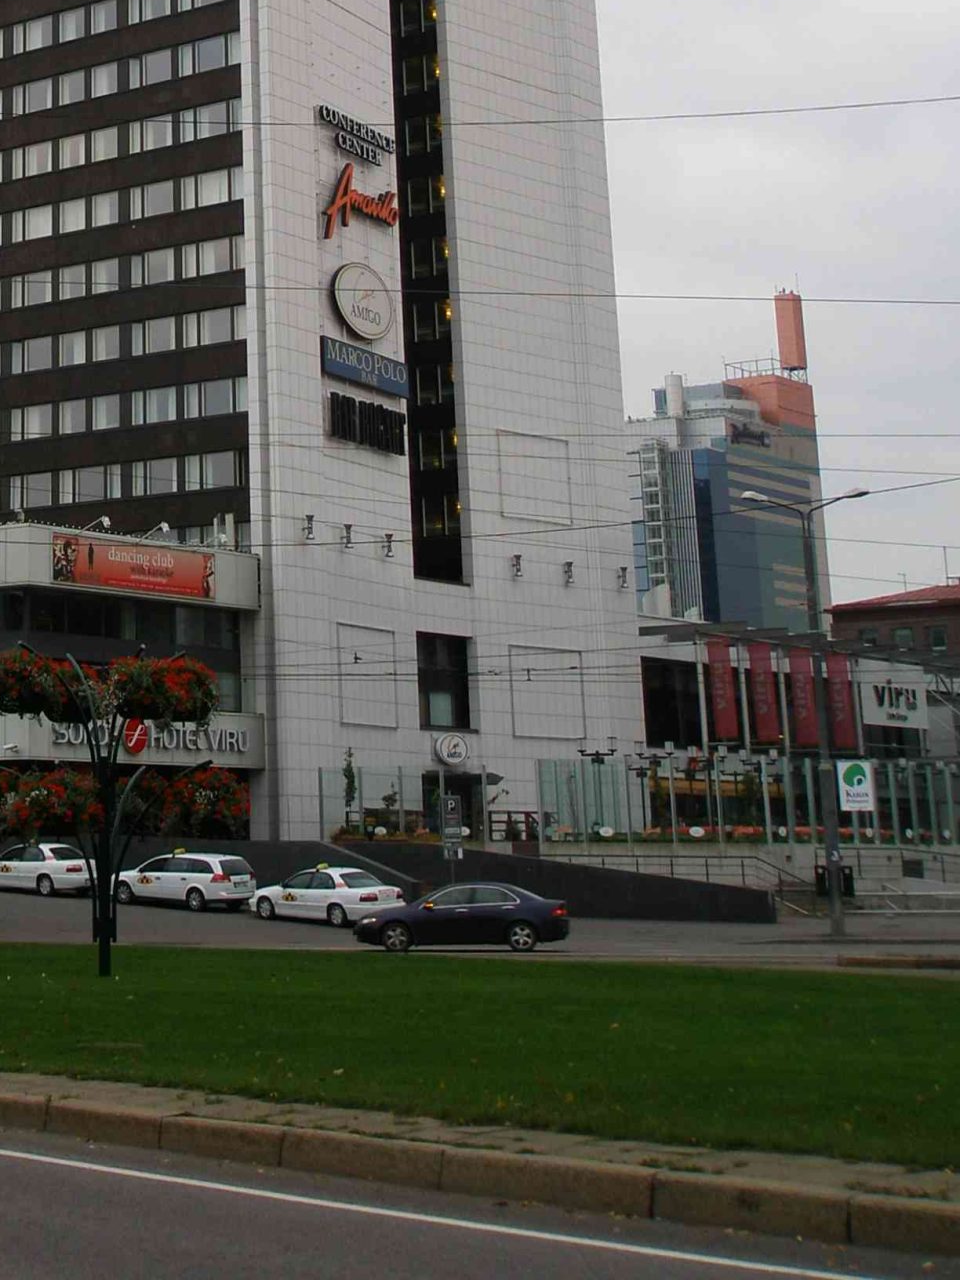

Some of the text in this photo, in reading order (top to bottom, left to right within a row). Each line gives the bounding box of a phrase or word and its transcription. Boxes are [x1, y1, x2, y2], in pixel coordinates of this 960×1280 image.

[320, 104, 396, 153] CONFERENCE
[337, 131, 382, 166] CENTER
[350, 304, 381, 326] AMIGO
[327, 339, 407, 384] MARCO POLO
[108, 546, 174, 569] dancing club
[208, 727, 250, 752] VIRU
[448, 800, 455, 811] P
